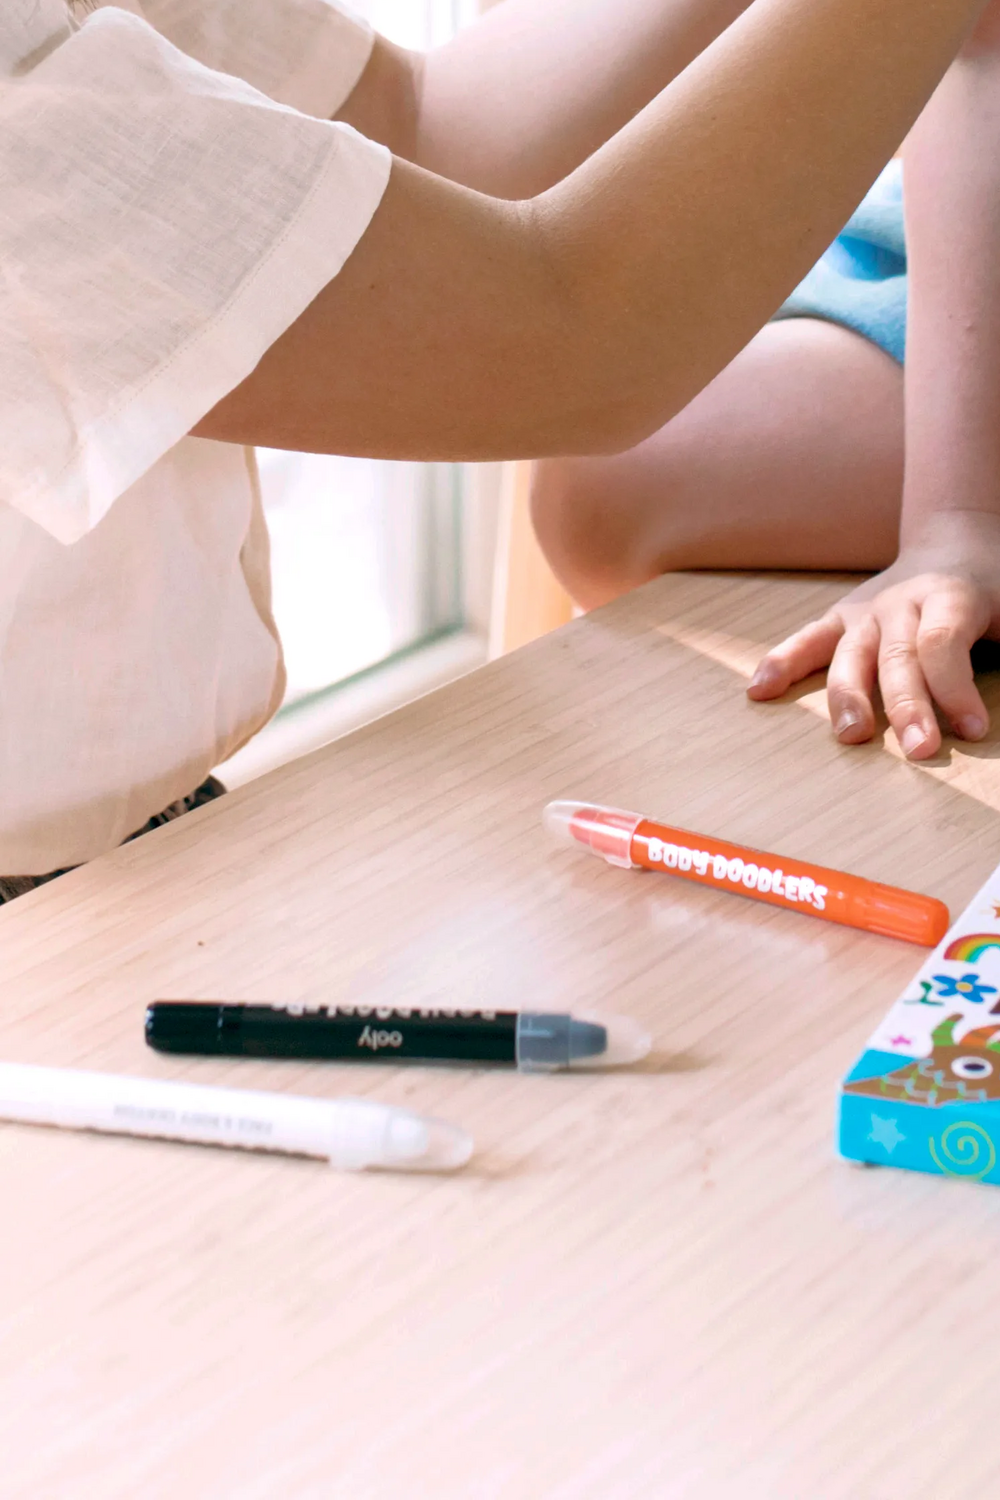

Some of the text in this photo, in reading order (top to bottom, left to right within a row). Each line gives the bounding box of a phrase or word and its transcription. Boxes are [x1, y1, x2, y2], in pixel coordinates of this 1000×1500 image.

[647, 837, 829, 911] BODY DOODLERS
[357, 1025, 403, 1050] ooly
